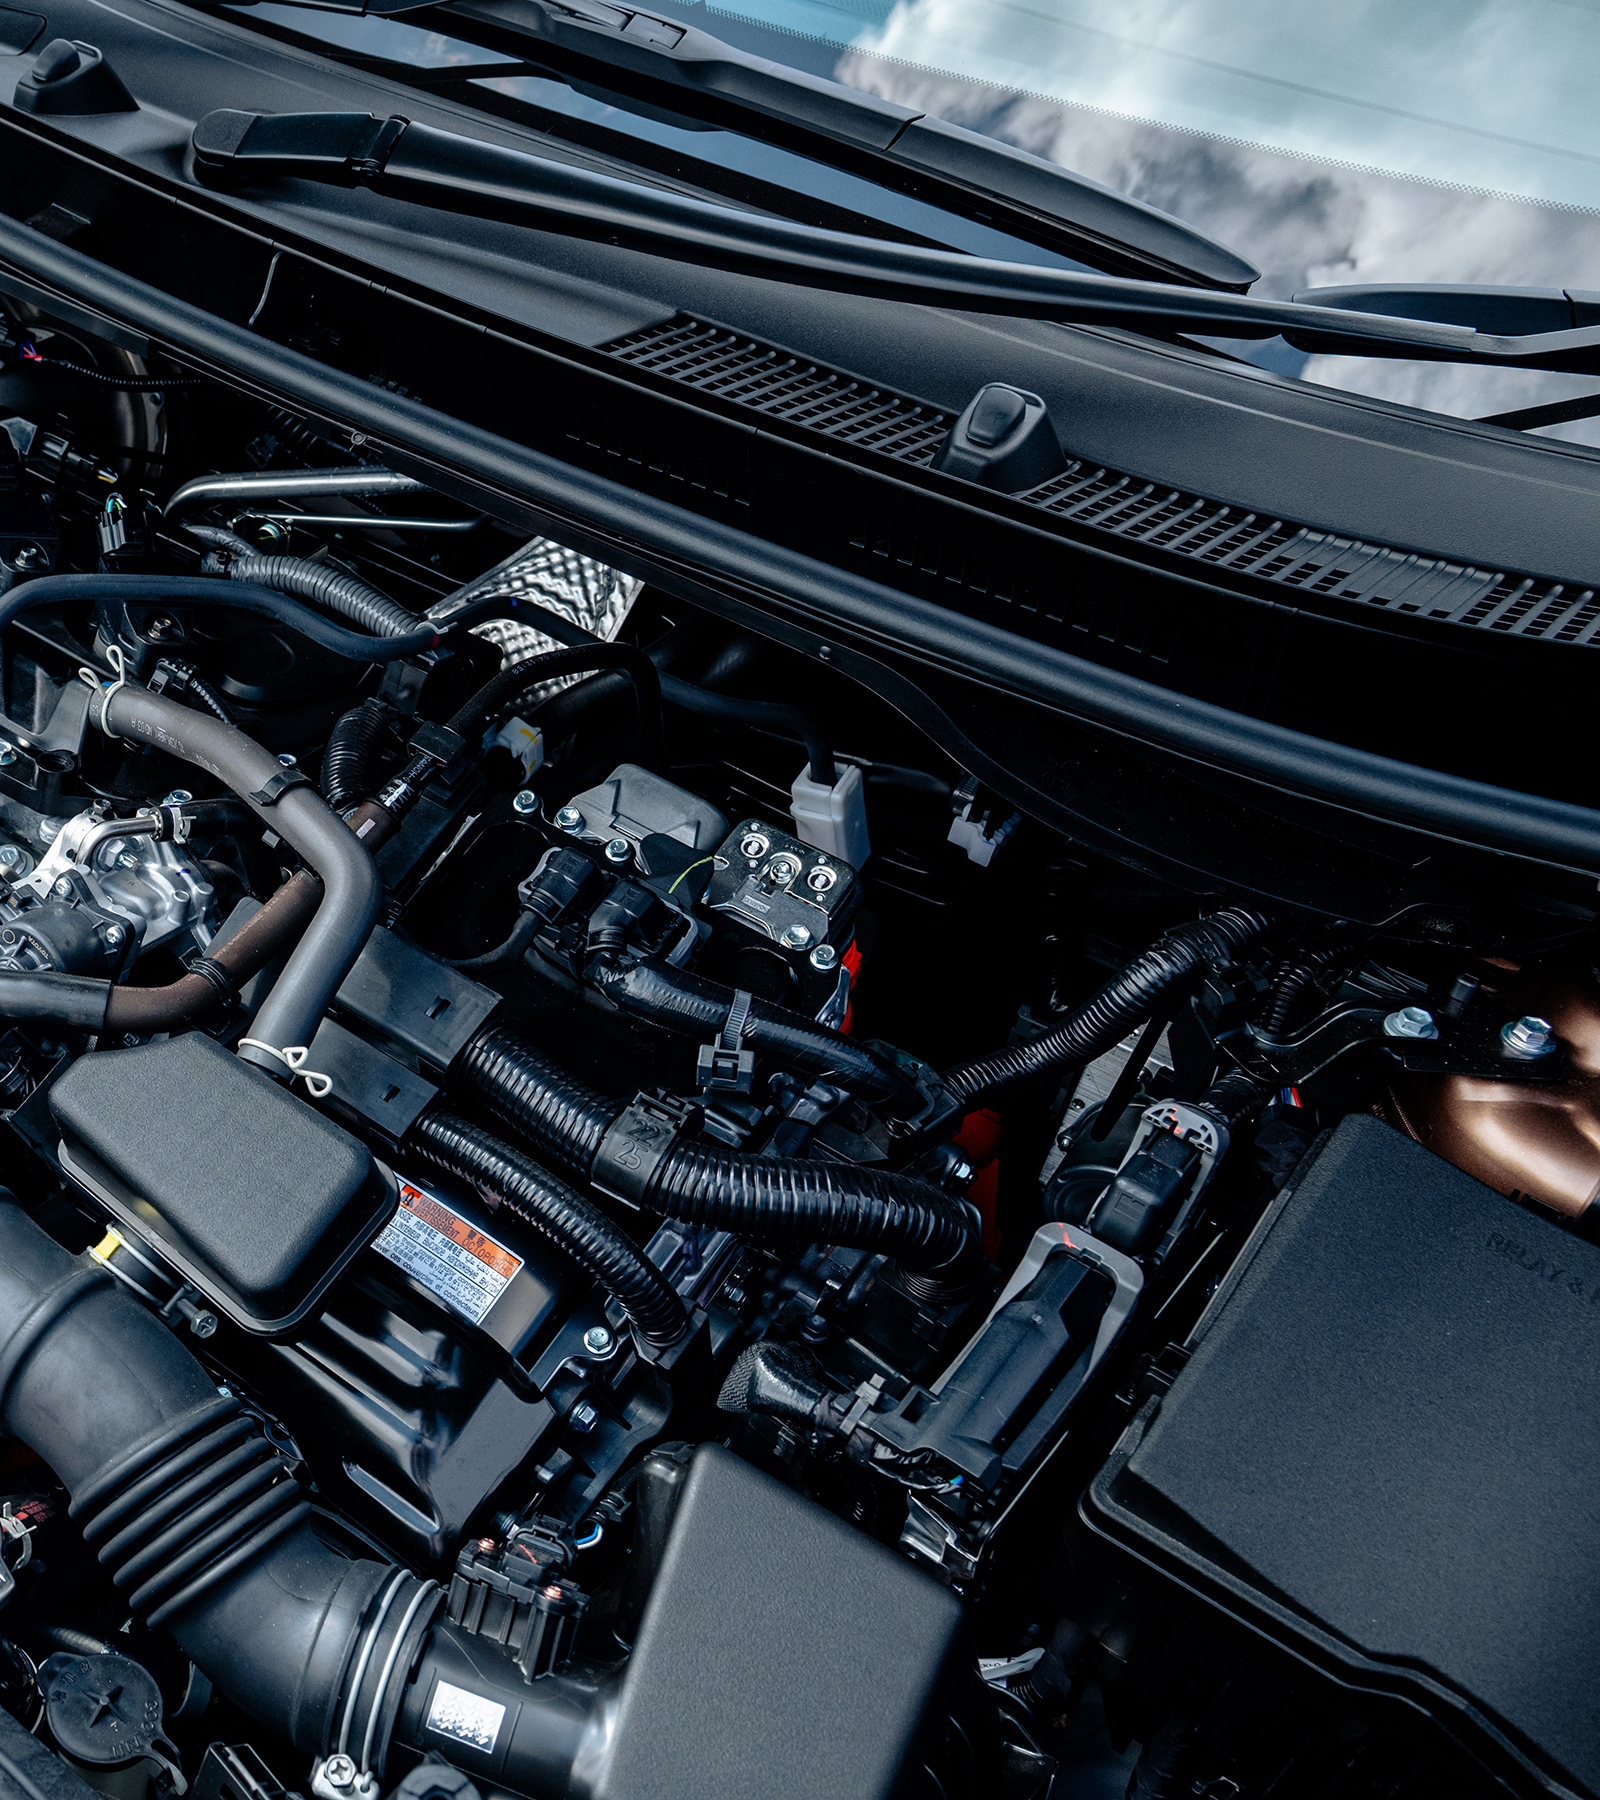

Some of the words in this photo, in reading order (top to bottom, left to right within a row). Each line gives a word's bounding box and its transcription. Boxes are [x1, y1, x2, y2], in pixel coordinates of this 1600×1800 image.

[28, 935, 49, 960] TOYOTA
[629, 1117, 665, 1150] 22
[610, 1138, 645, 1171] 25
[411, 1203, 460, 1240] AVERTISSEMENT
[417, 1196, 456, 1226] WARNING
[389, 1252, 402, 1263] ces
[402, 1260, 434, 1285] couvercles
[434, 1283, 442, 1291] et
[400, 1237, 417, 1250] these
[417, 1248, 437, 1264] covers
[437, 1261, 457, 1277] and/or
[460, 1236, 514, 1277] ОСТОРОЖНО
[1485, 1230, 1565, 1286] RELAY
